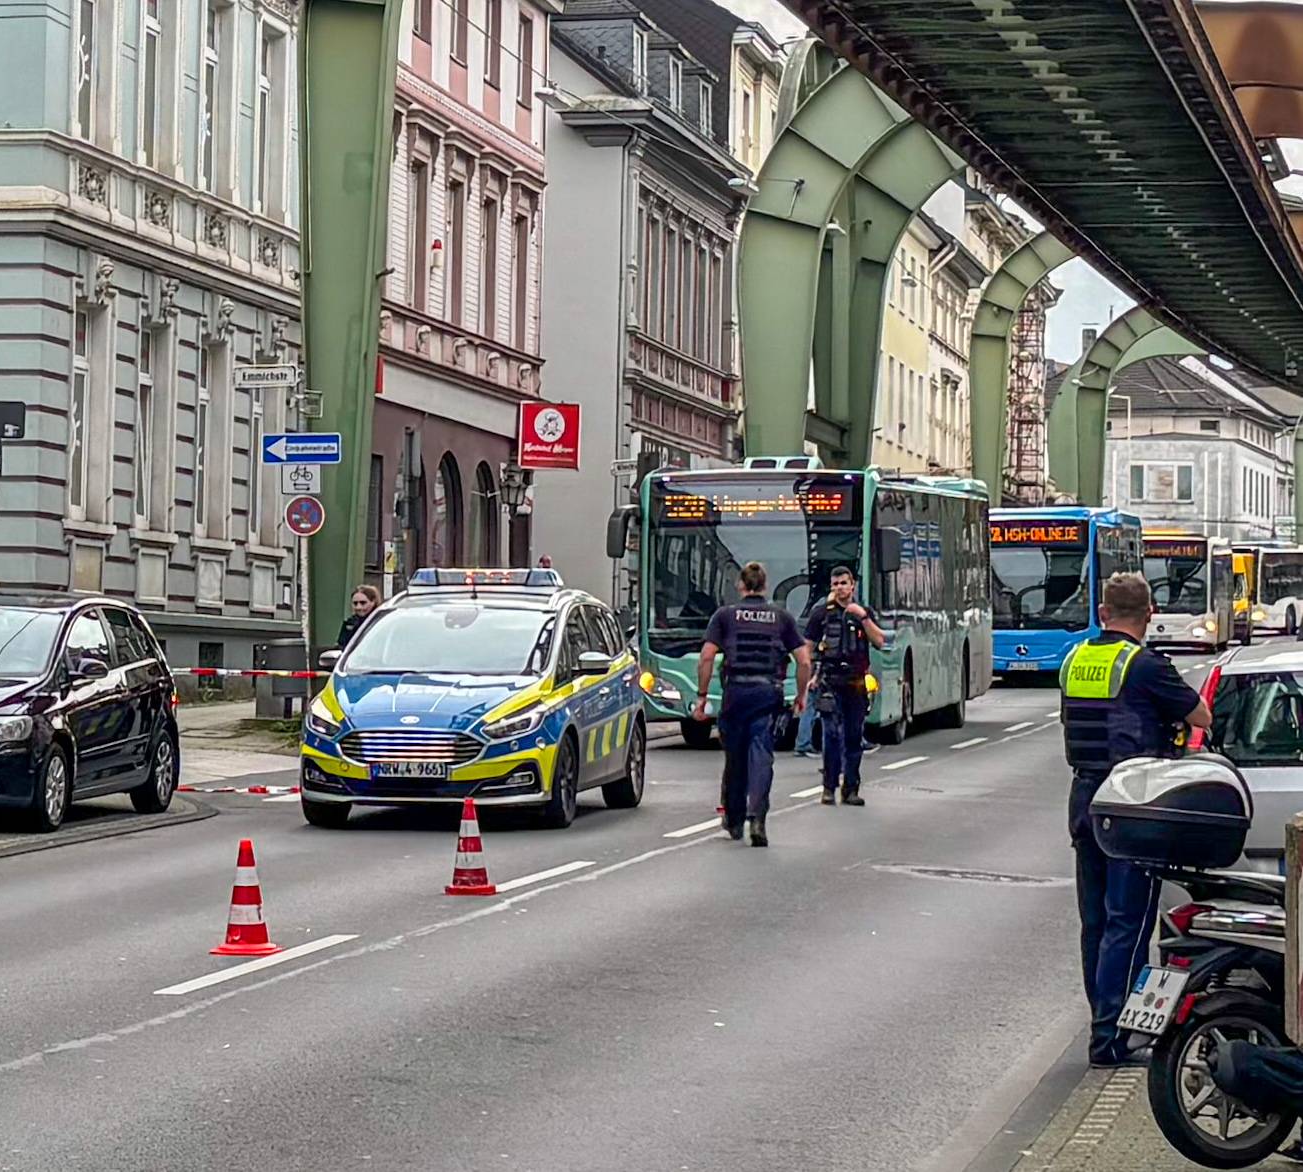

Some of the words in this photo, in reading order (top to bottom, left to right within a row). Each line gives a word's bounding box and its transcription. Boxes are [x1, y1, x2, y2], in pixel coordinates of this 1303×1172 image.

[736, 609, 776, 624] POLIZEI
[1070, 665, 1108, 682] POLIZEI
[1158, 971, 1171, 988] W
[1120, 1009, 1138, 1027] AX
[1138, 1011, 1165, 1030] 219
